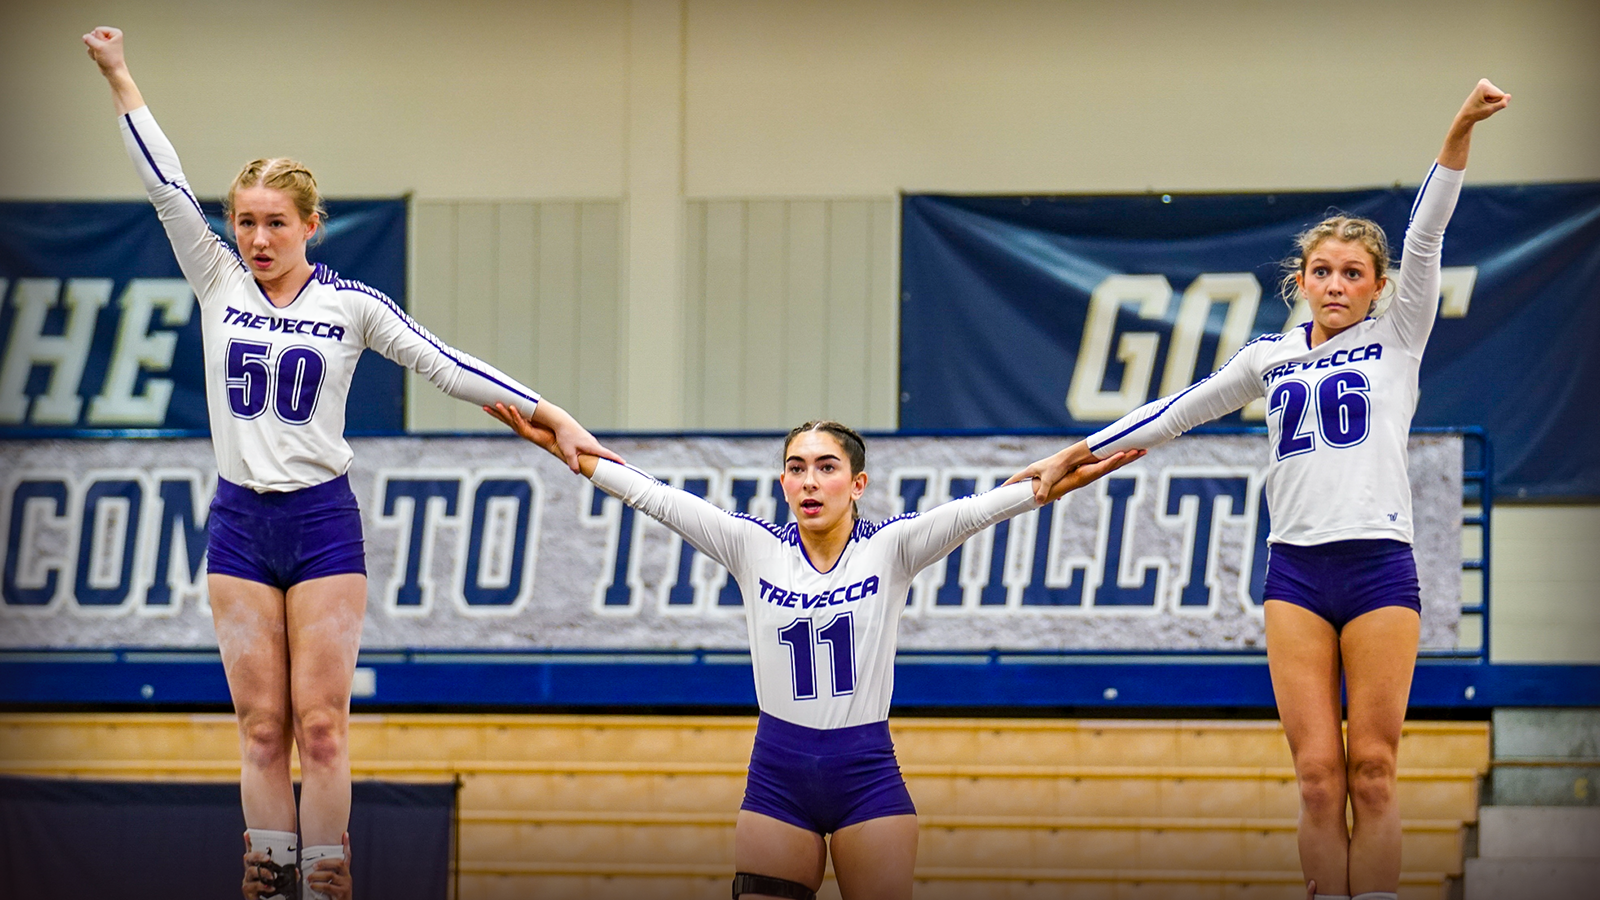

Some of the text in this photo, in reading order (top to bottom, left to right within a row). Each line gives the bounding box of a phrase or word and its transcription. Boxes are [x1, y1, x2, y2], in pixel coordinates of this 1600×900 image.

[0, 277, 196, 426] HE
[222, 305, 346, 342] TREVECCA
[1262, 342, 1383, 387] TREVECCA
[224, 337, 327, 426] 50
[1268, 368, 1371, 462] 26
[381, 477, 535, 608] TO
[590, 476, 796, 607] TH
[758, 574, 880, 609] TREVECCA
[777, 610, 857, 701] 11
